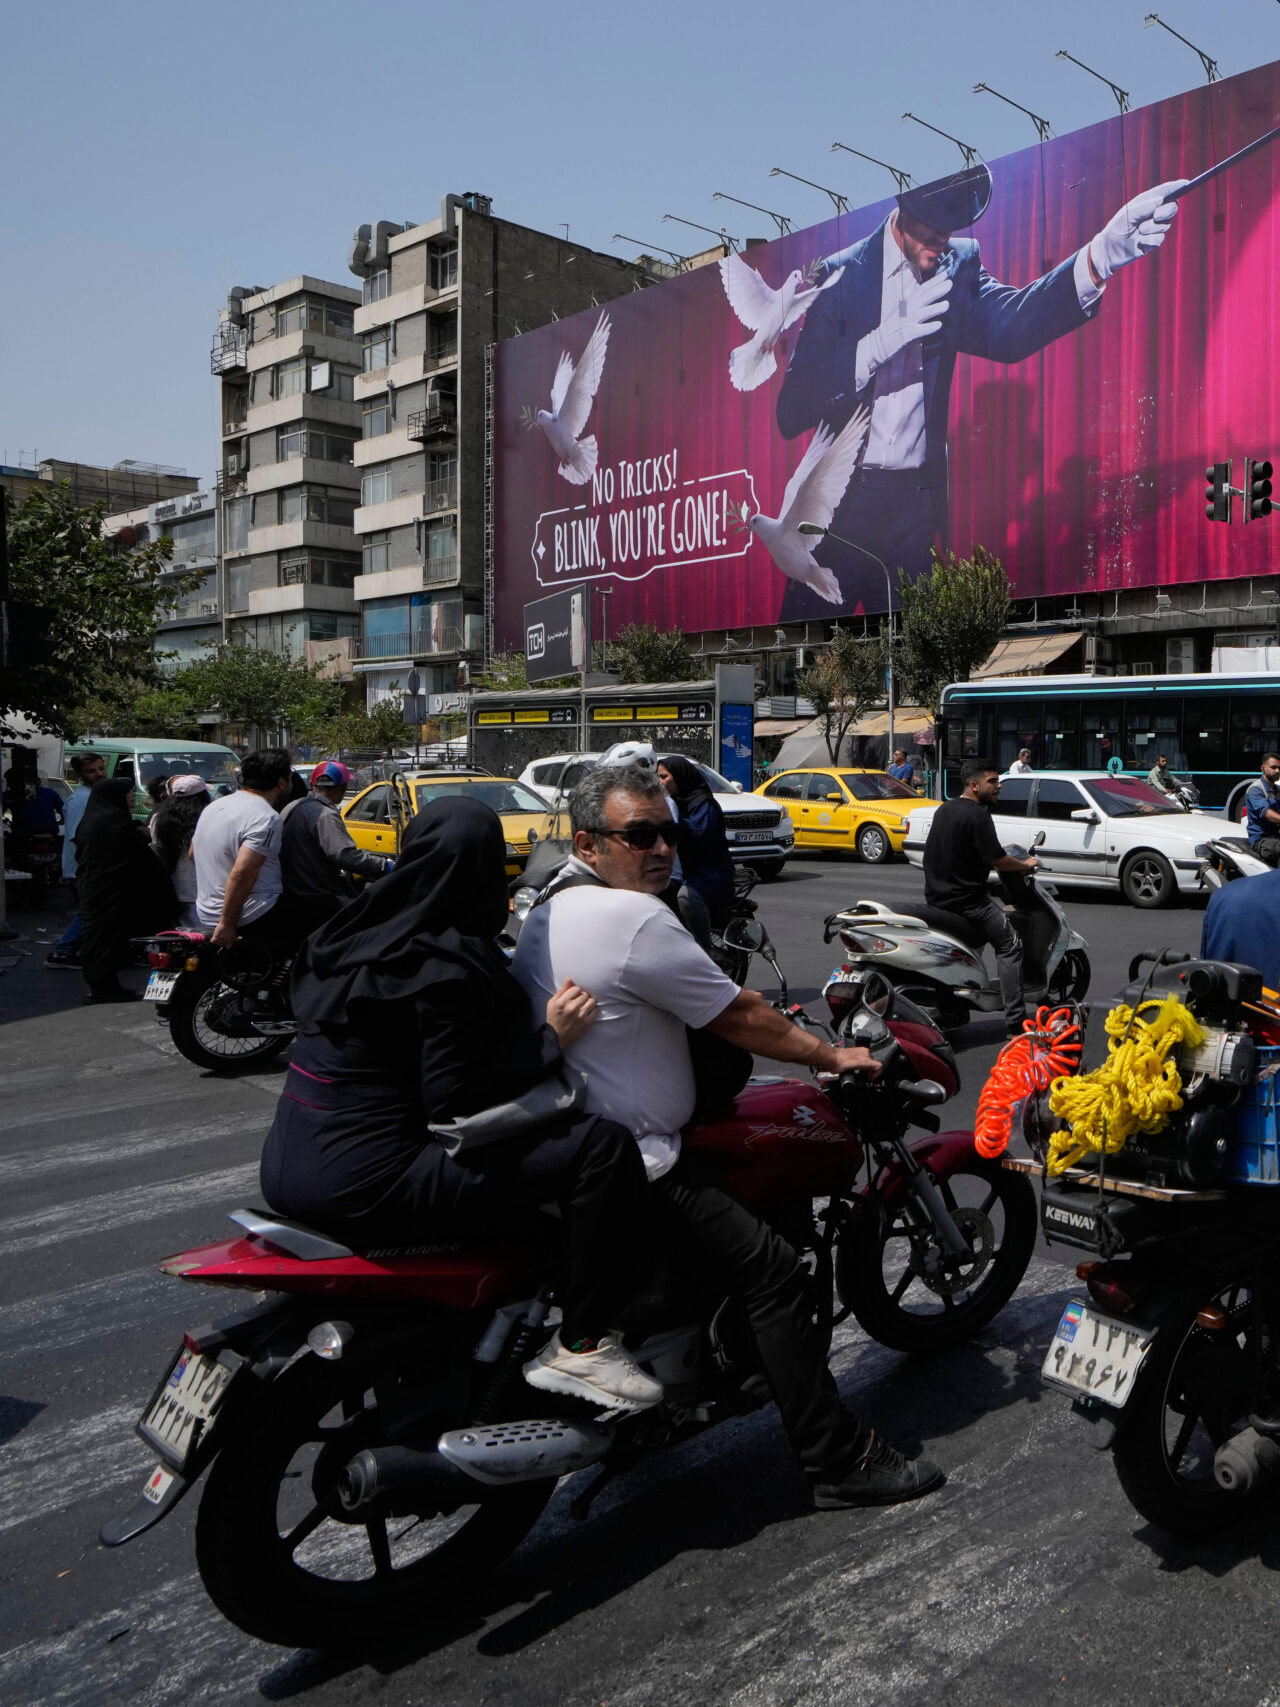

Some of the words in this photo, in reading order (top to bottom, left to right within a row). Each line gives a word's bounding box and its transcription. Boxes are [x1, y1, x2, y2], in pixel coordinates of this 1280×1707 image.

[592, 467, 615, 507] NO
[618, 448, 677, 499] TRICKS!
[554, 514, 606, 573] BLINK,
[609, 502, 665, 563] YOU'RE
[670, 489, 728, 554] GONE!
[528, 631, 543, 652] TCH
[1045, 1205, 1096, 1231] KEEWAY
